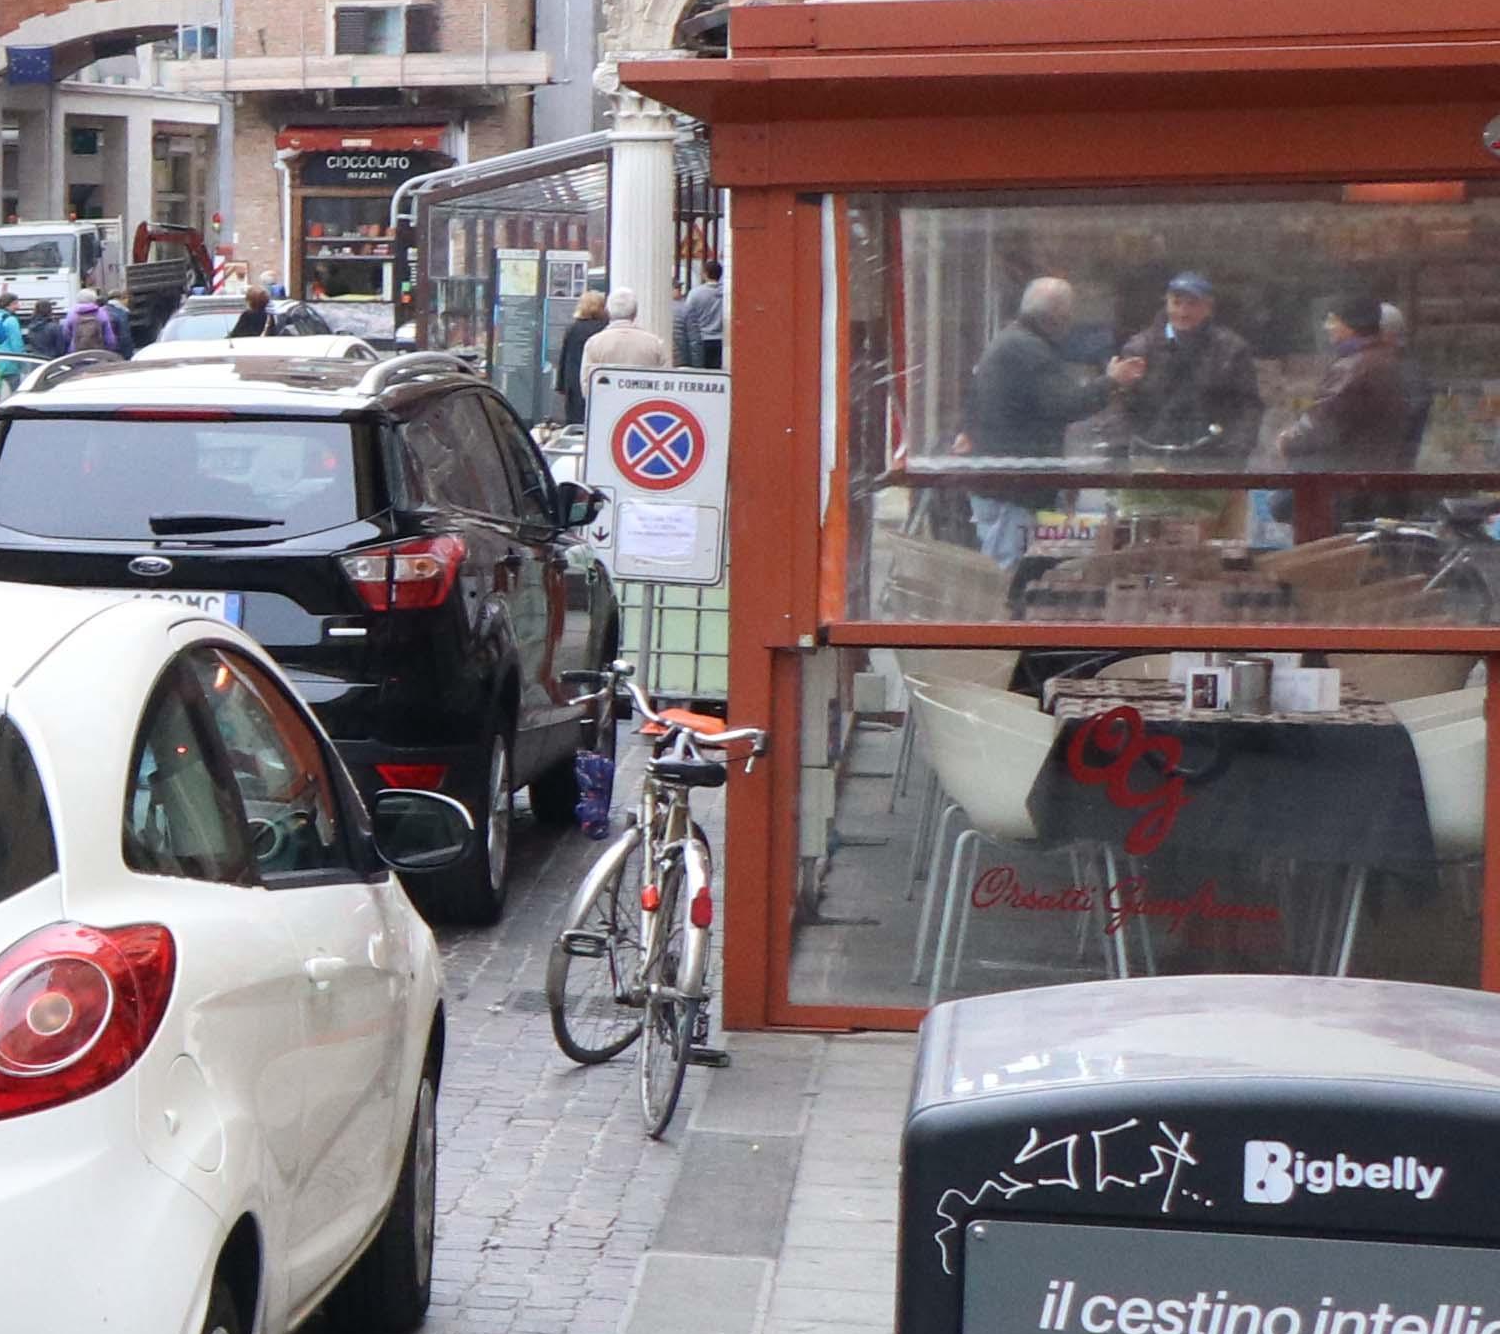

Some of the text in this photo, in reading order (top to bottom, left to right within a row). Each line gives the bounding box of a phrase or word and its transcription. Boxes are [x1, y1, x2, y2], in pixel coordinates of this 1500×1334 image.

[326, 156, 410, 169] CIOCCOLATO
[618, 378, 726, 394] COMUNE DI FERRARA
[1243, 1140, 1443, 1204] Bigbelly
[1038, 1280, 1075, 1332] il
